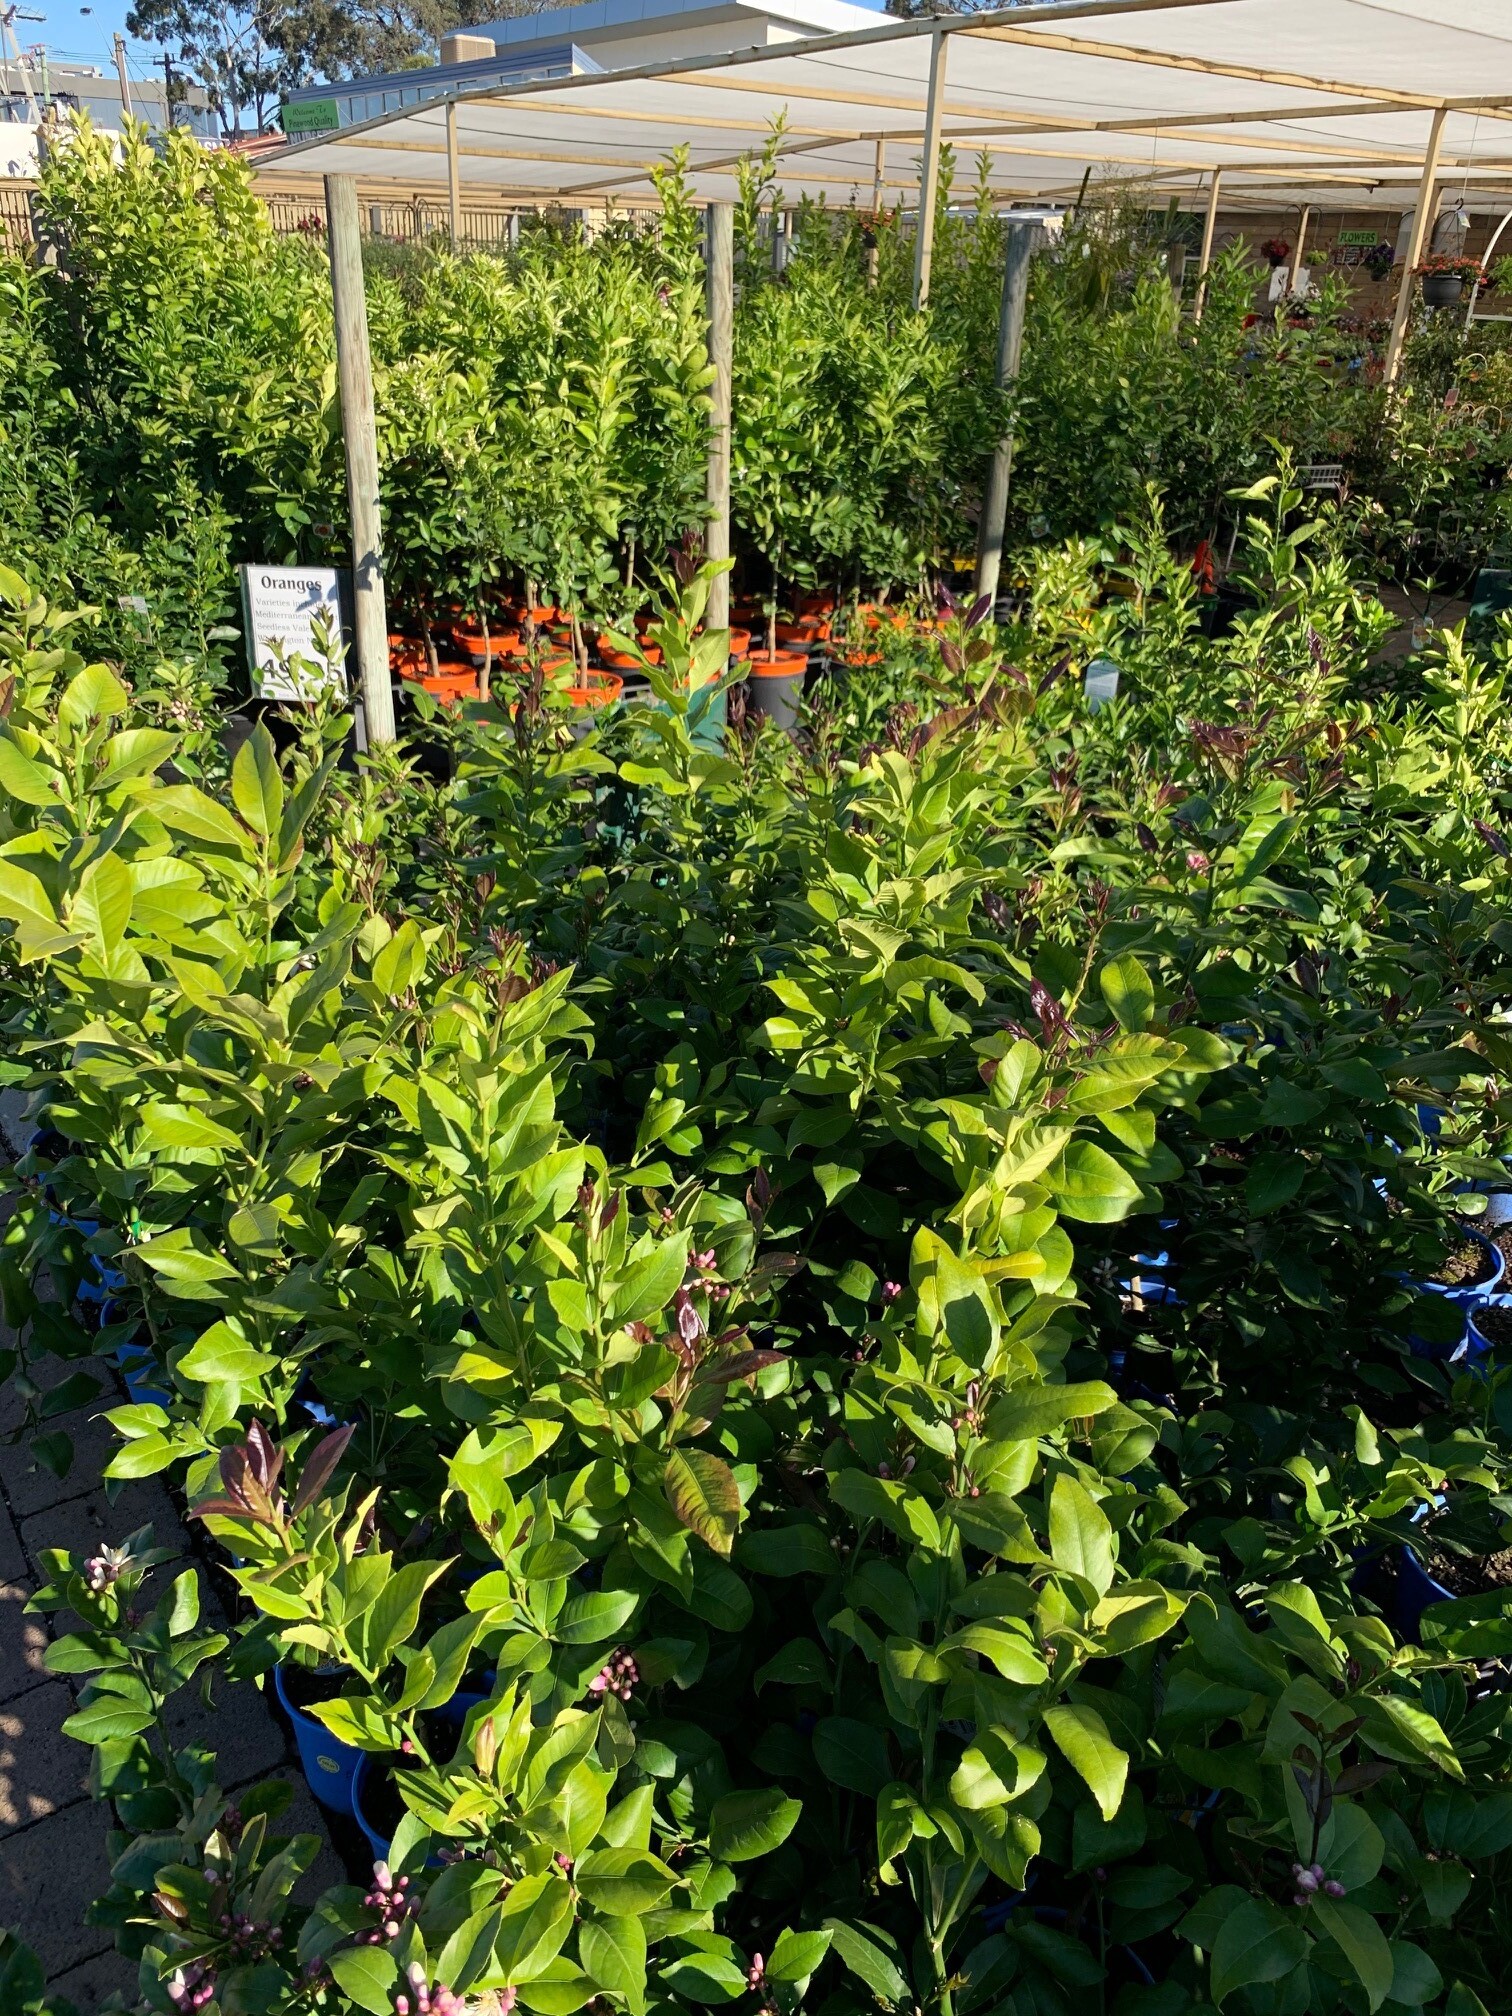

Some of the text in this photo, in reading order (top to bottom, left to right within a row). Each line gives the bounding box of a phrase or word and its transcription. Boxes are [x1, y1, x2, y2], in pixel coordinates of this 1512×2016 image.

[314, 114, 333, 127] Quality
[1340, 232, 1376, 243] FLOWERS
[261, 575, 322, 594] Oranges
[255, 598, 290, 607] Varieties
[255, 610, 311, 620] Mediterranean
[257, 622, 291, 632] Seedless
